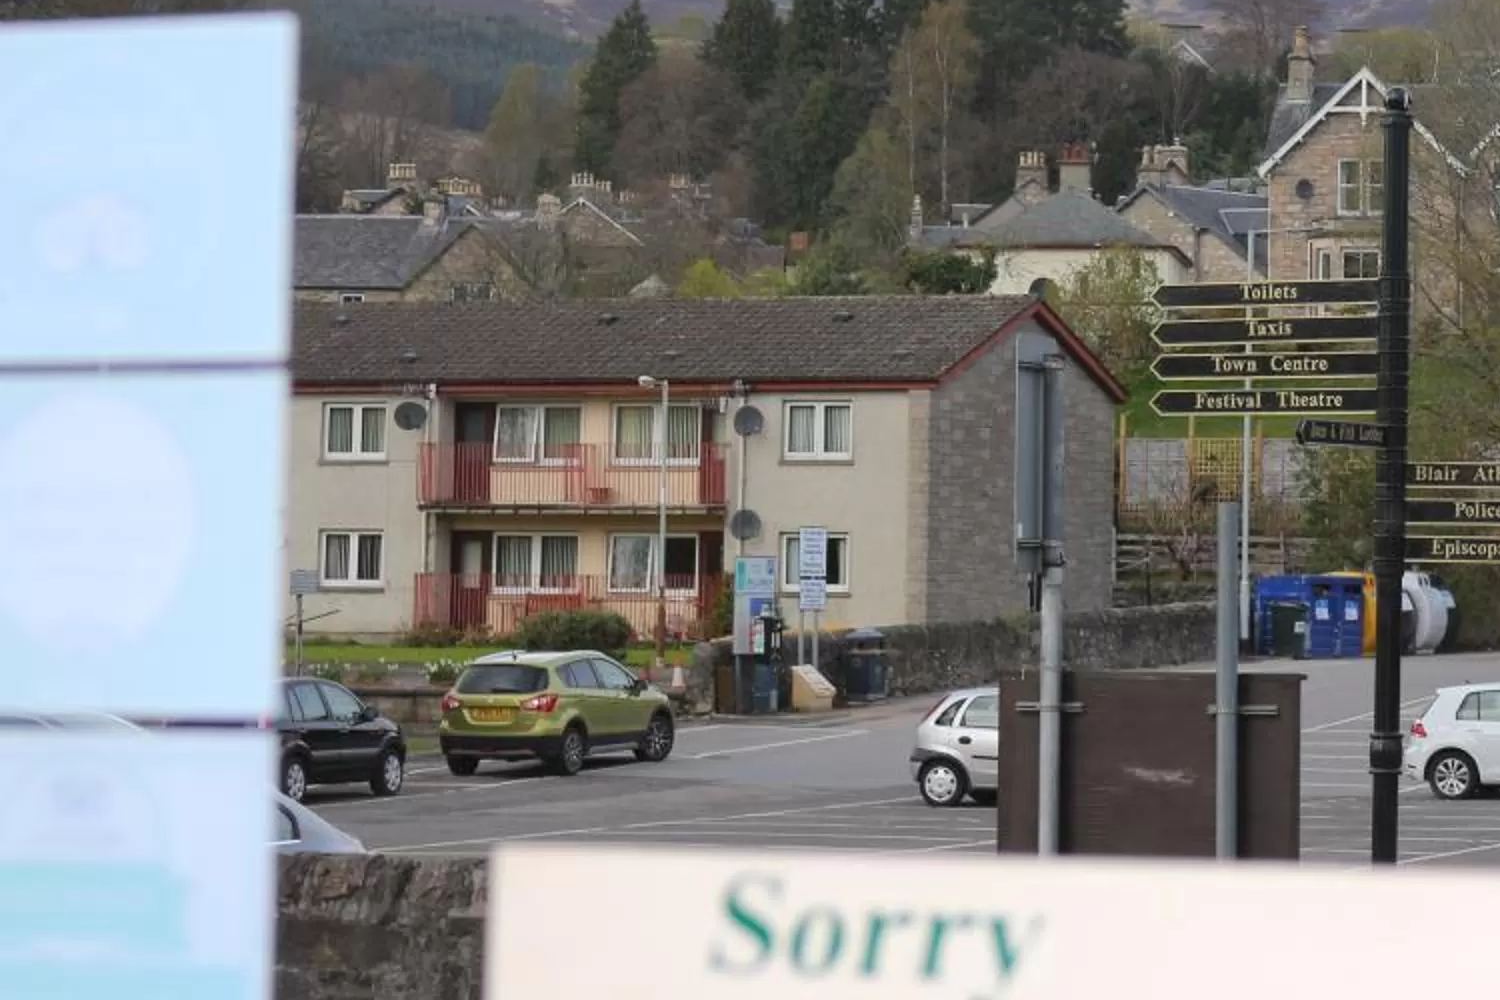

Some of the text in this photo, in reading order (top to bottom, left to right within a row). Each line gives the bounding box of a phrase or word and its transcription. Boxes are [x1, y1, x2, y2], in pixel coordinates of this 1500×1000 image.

[1240, 283, 1298, 300] Toilets
[1246, 320, 1293, 337] Taxis
[1211, 355, 1328, 373] Town Centre
[1194, 391, 1343, 409] Festival Theatre
[1415, 465, 1460, 482] Blair
[707, 868, 1048, 1000] Sorry
